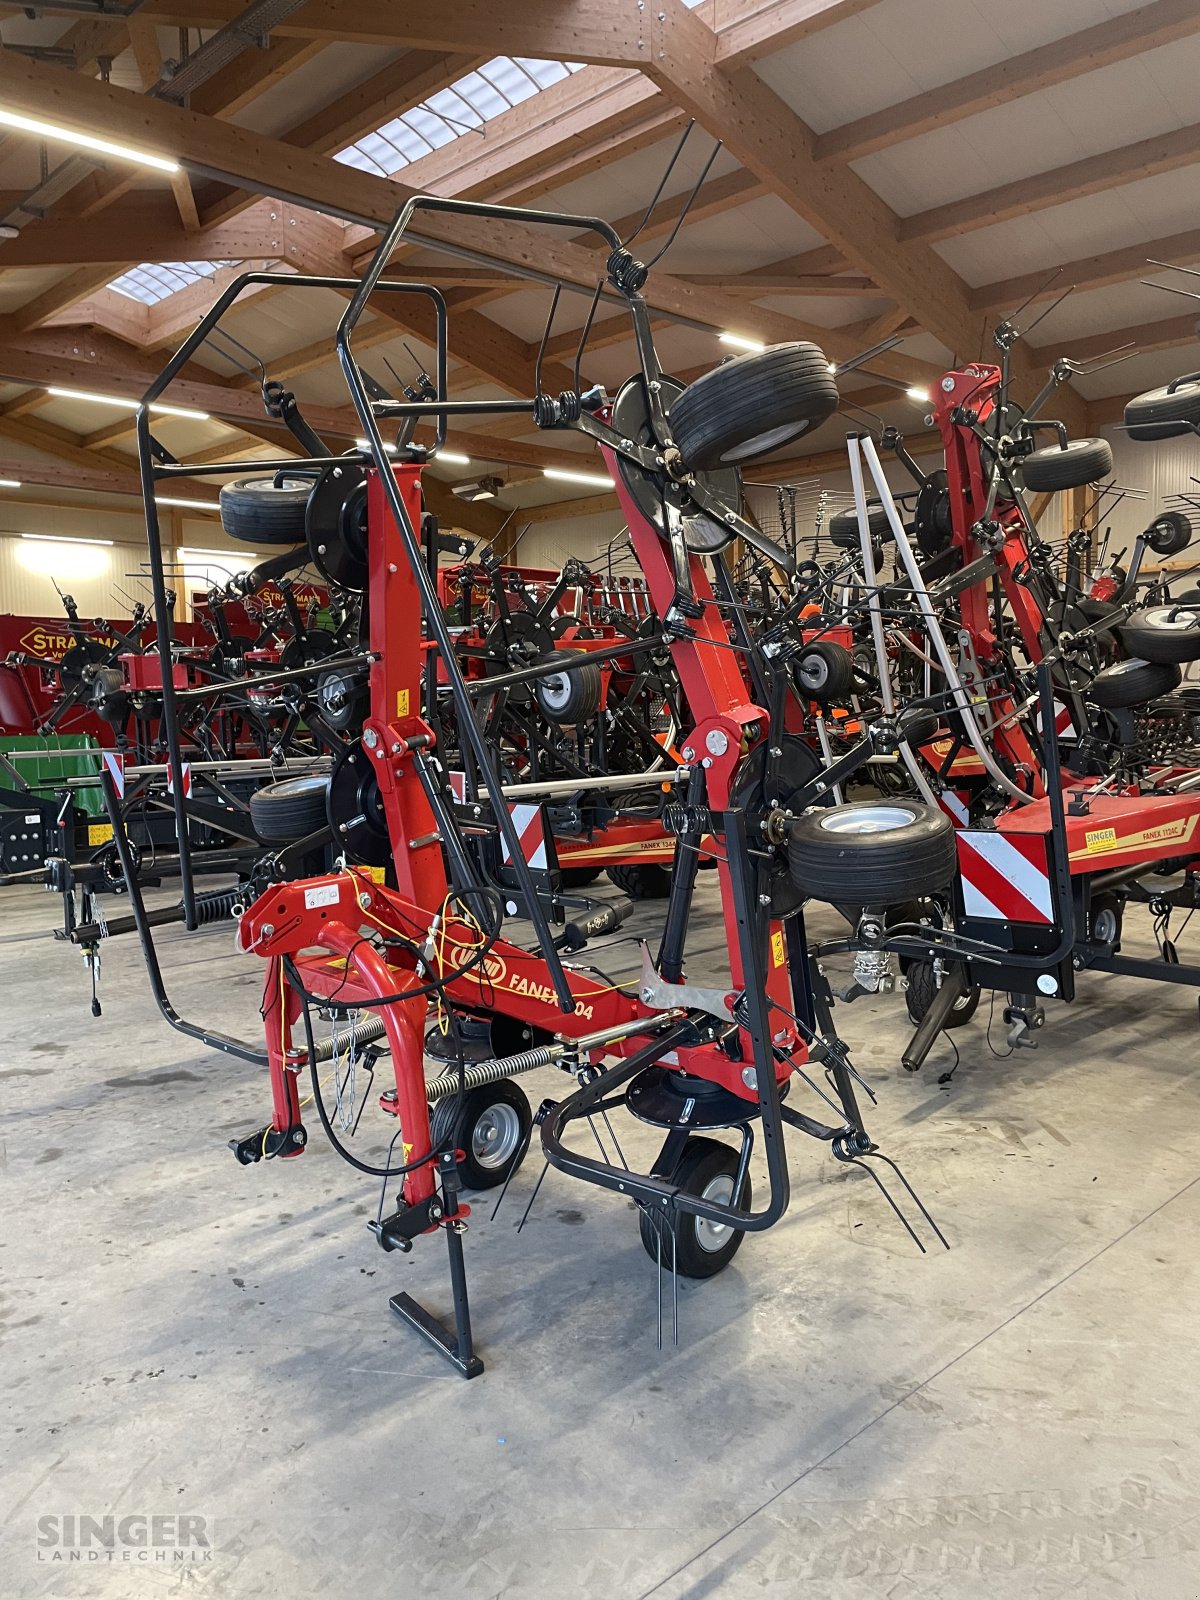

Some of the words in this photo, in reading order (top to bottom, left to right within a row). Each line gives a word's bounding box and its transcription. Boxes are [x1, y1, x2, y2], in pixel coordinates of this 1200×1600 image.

[34, 634, 142, 650] STRAMA
[1087, 830, 1114, 842] SINGER
[1143, 832, 1161, 843] FANEX
[641, 840, 661, 849] FANEX
[509, 974, 559, 1008] FANEX
